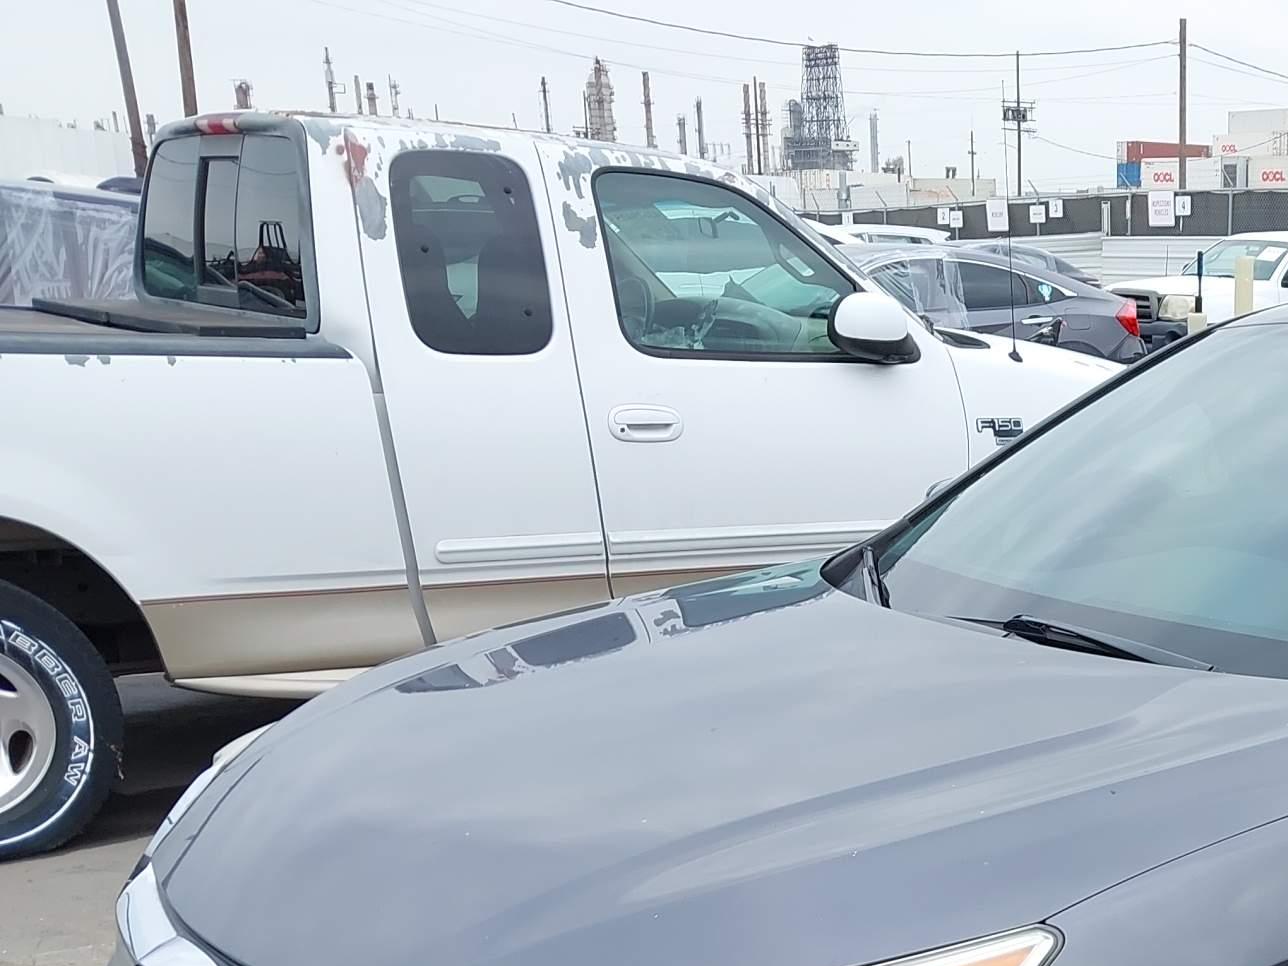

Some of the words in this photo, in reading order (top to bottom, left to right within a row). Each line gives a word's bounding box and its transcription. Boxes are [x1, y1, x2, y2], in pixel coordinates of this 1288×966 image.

[1153, 172, 1175, 183] OOCL
[1261, 170, 1286, 182] OOCL
[64, 735, 90, 787] AW
